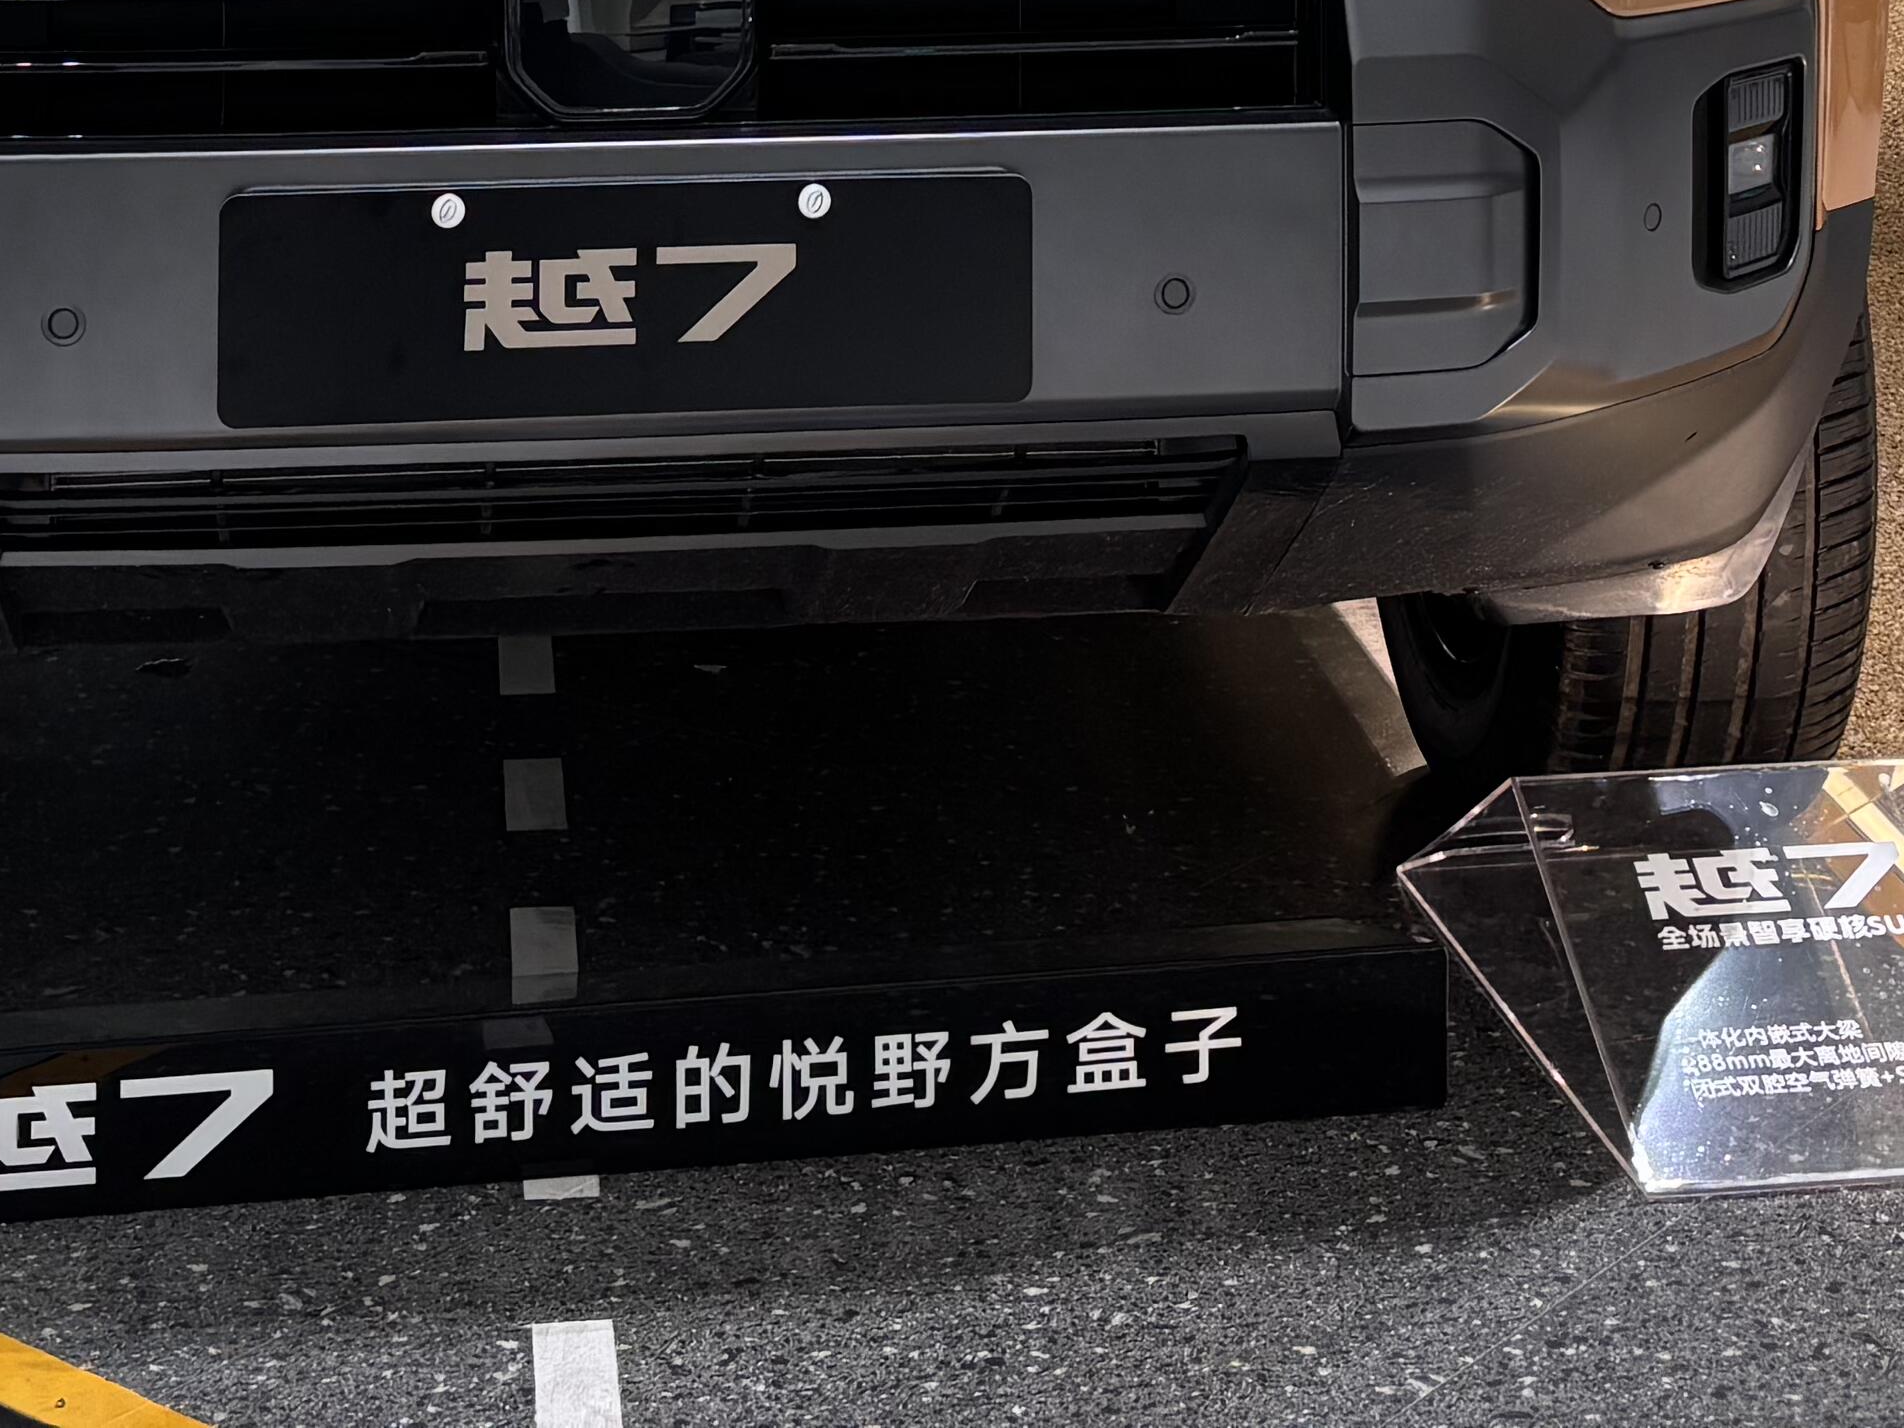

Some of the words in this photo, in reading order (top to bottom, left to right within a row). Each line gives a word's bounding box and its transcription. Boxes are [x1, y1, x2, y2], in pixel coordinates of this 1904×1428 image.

[463, 242, 797, 352] 越7
[1633, 841, 1900, 921] 越7
[365, 1005, 1244, 1153] 超舒适的悦野方盒子
